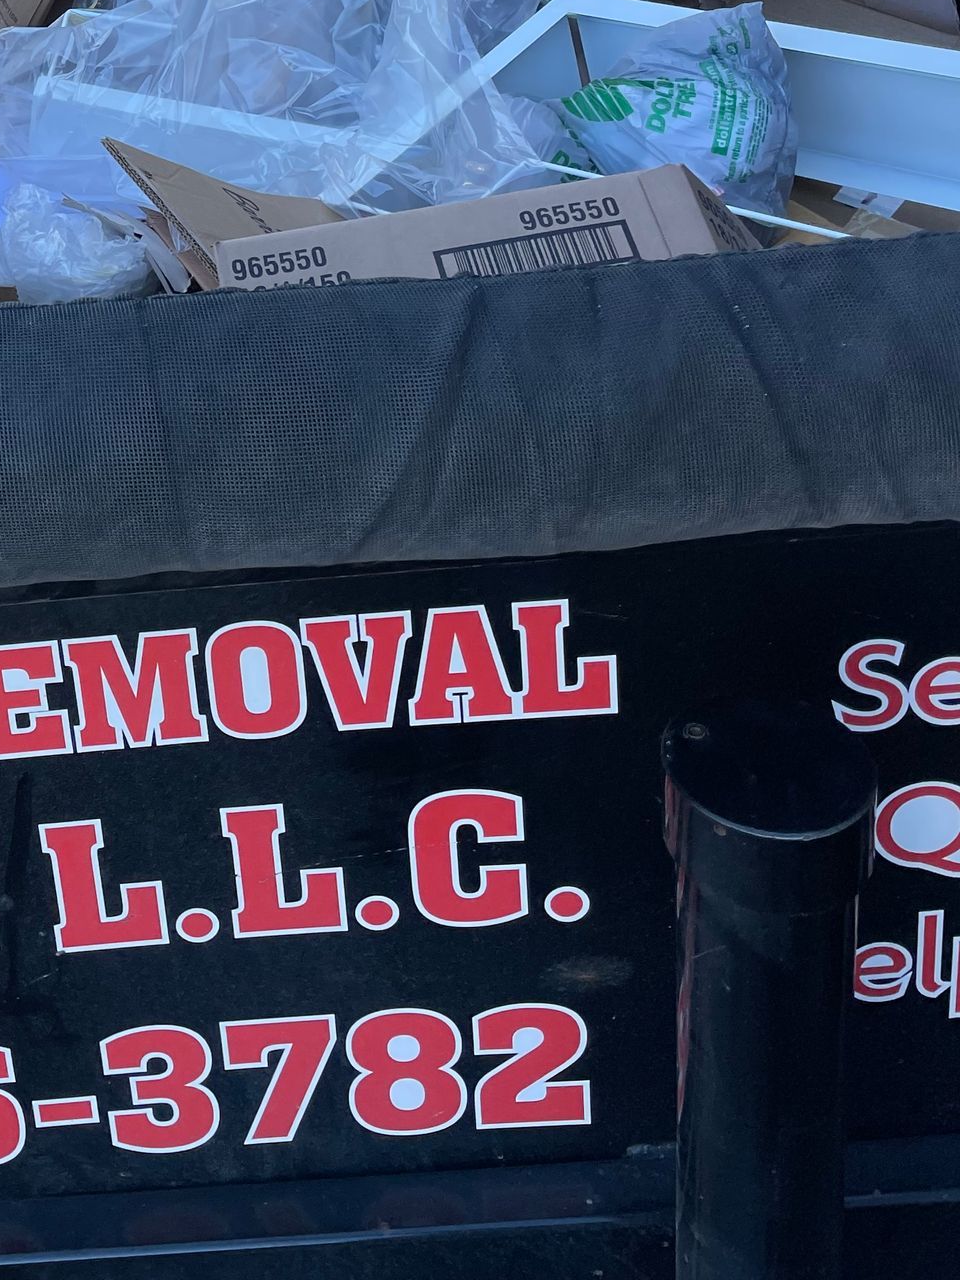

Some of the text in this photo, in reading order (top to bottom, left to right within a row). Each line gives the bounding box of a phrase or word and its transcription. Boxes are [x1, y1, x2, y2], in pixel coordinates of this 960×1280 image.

[519, 196, 620, 231] 965550
[231, 246, 327, 281] 965550
[37, 788, 592, 954] L.L.C.
